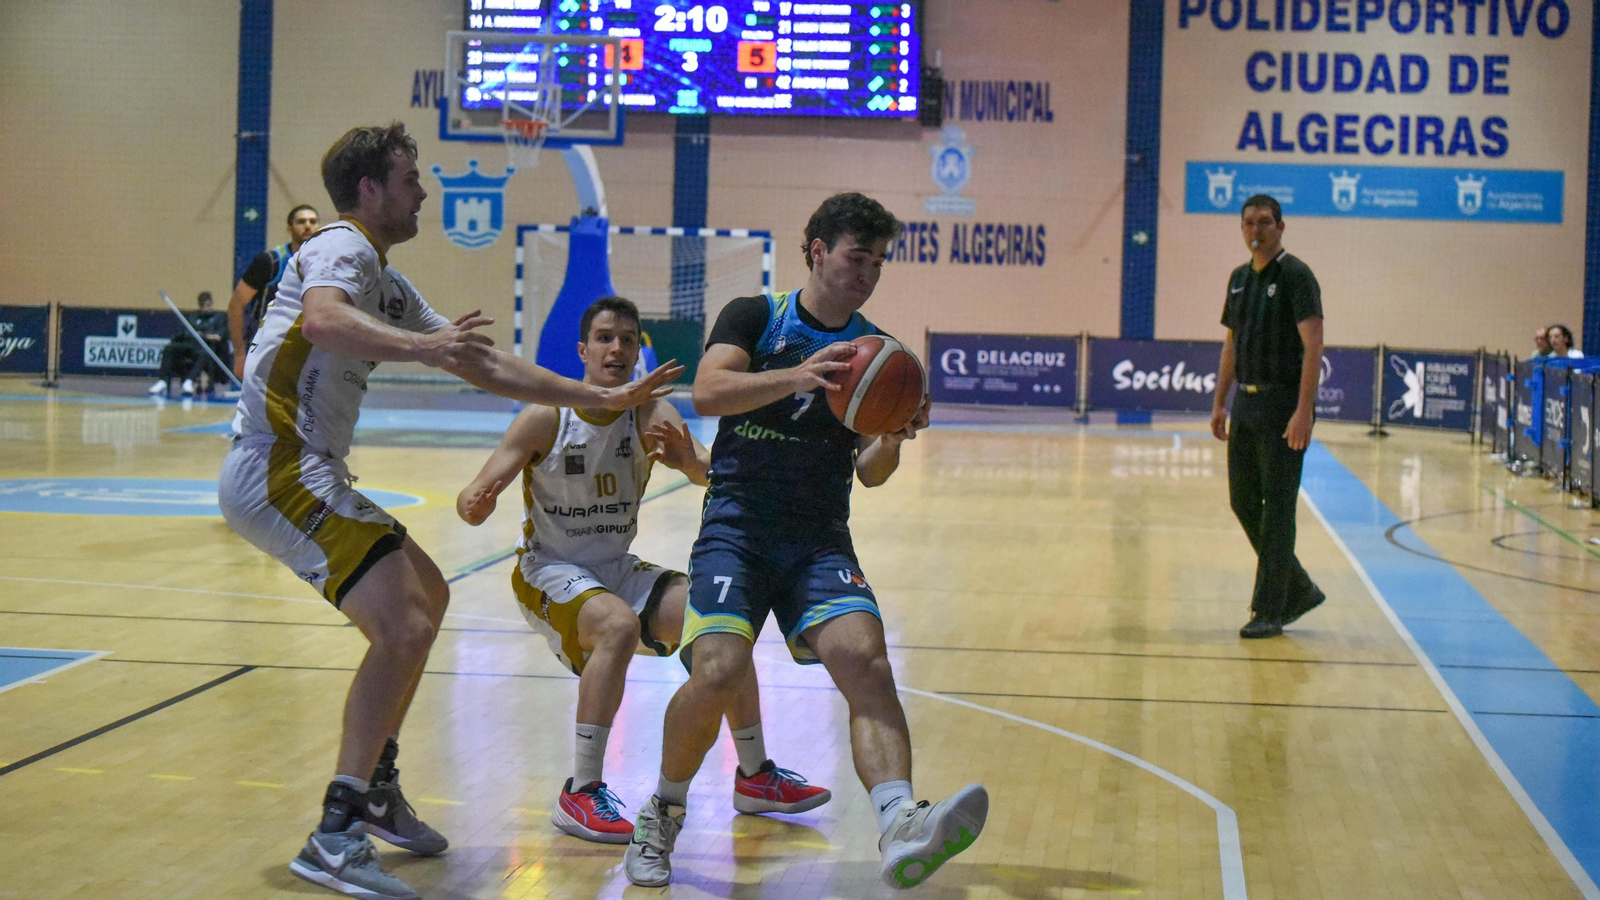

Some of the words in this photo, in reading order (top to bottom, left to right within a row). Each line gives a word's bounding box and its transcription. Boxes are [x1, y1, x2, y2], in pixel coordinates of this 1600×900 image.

[653, 4, 728, 33] 2:10
[1178, 0, 1570, 38] POLIDEPORTIVO
[681, 51, 699, 72] 3
[750, 48, 764, 66] 5
[1245, 51, 1430, 94] CIUDAD
[1449, 55, 1510, 95] DE
[411, 70, 446, 109] AYU
[960, 79, 1054, 122] MUNICIPAL
[1236, 111, 1510, 158] ALGECIRAS
[886, 221, 939, 264] ORTES
[950, 222, 1047, 266] ALGECIRAS
[976, 349, 1066, 367] DELACRUZ
[1112, 359, 1217, 393] Socibus
[594, 472, 617, 498] 10
[543, 500, 638, 518] JUARIST
[566, 522, 635, 538] ORAINGIPUZ
[713, 576, 733, 604] 7
